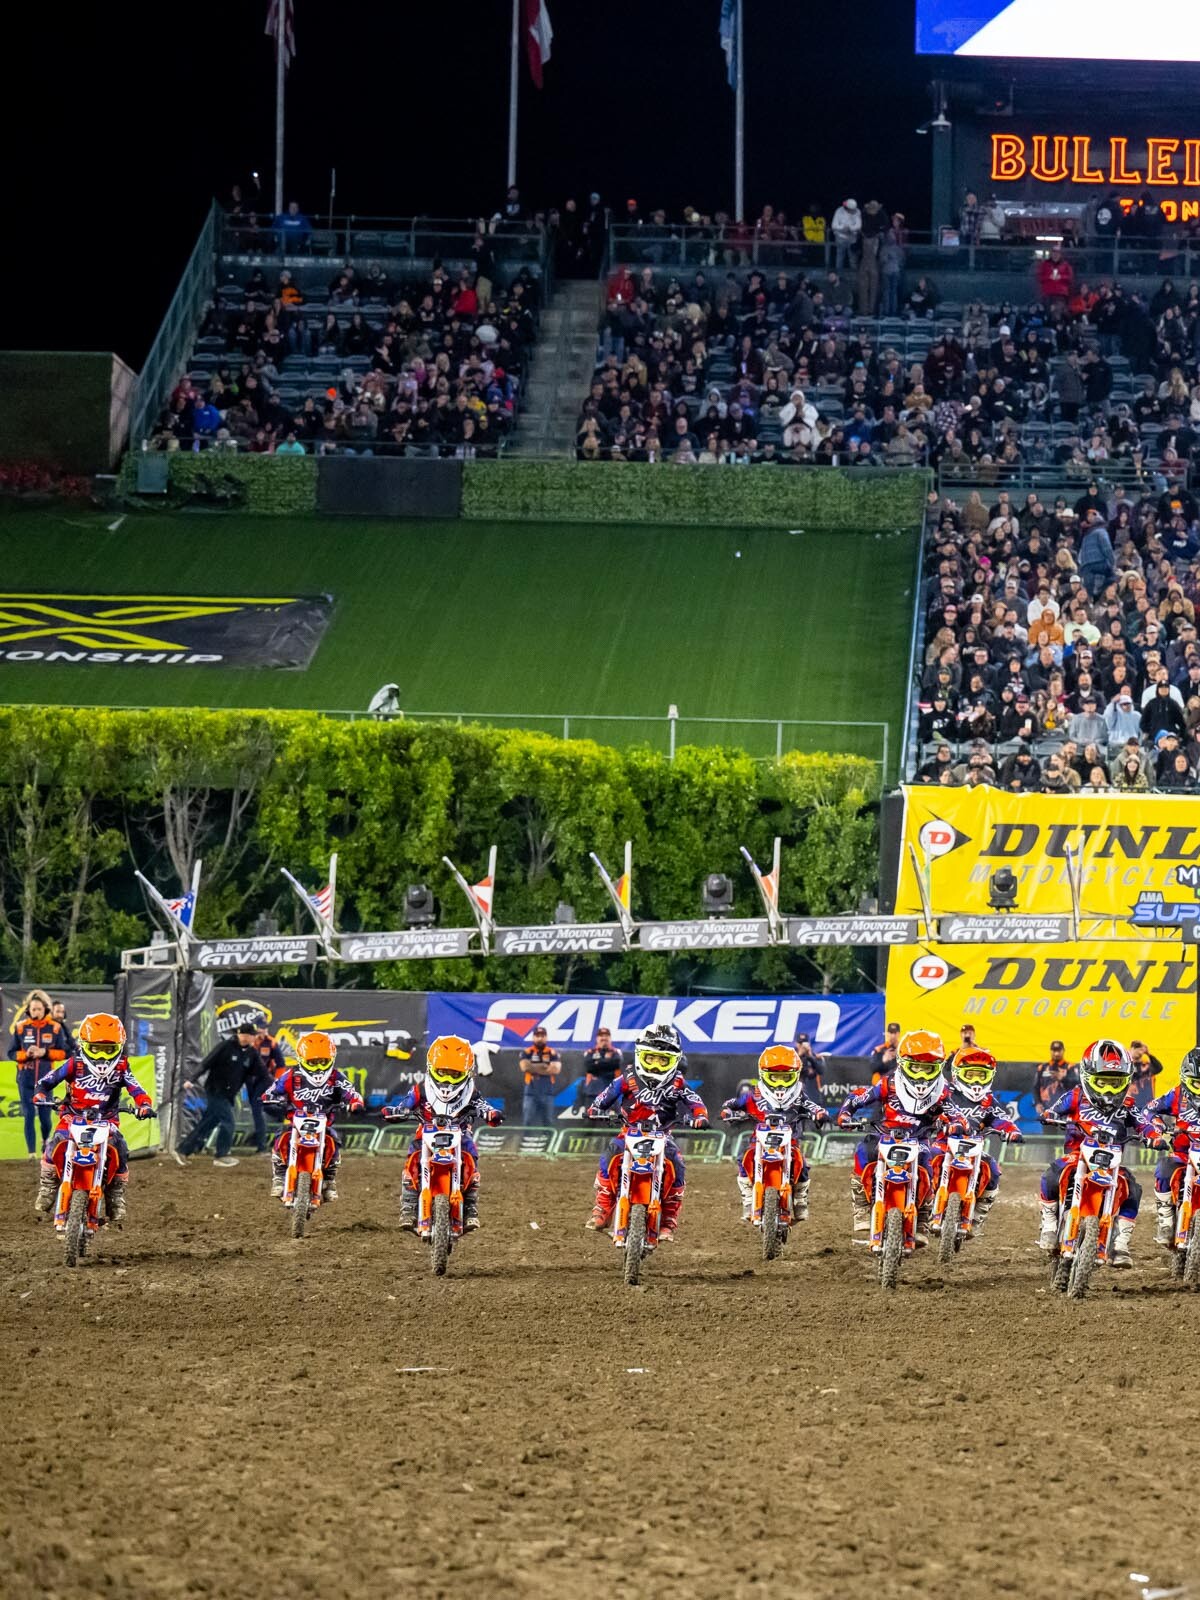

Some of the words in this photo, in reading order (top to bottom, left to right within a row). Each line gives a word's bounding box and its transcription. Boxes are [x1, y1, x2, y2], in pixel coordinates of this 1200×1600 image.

[968, 863, 1178, 889] MTORCYCLE
[1140, 892, 1162, 903] AMA
[815, 921, 849, 930] ROCKY
[850, 921, 908, 931] MOUNTAIN
[967, 917, 1001, 928] ROCKY
[1003, 918, 1060, 928] MOUNTAIN
[520, 929, 555, 939] ROCKY
[556, 928, 613, 938] MOUNTAIN
[666, 924, 700, 934] ROCKY
[702, 923, 759, 933] MOUNTAIN
[366, 935, 401, 946] ROCKY
[402, 933, 459, 943] MOUNTAIN
[216, 942, 250, 952] ROCKY
[251, 941, 308, 951] MOUNTAIN
[964, 997, 1178, 1022] MOTORCYCLE
[482, 999, 840, 1043] FALKEN
[764, 1132, 784, 1148] 5
